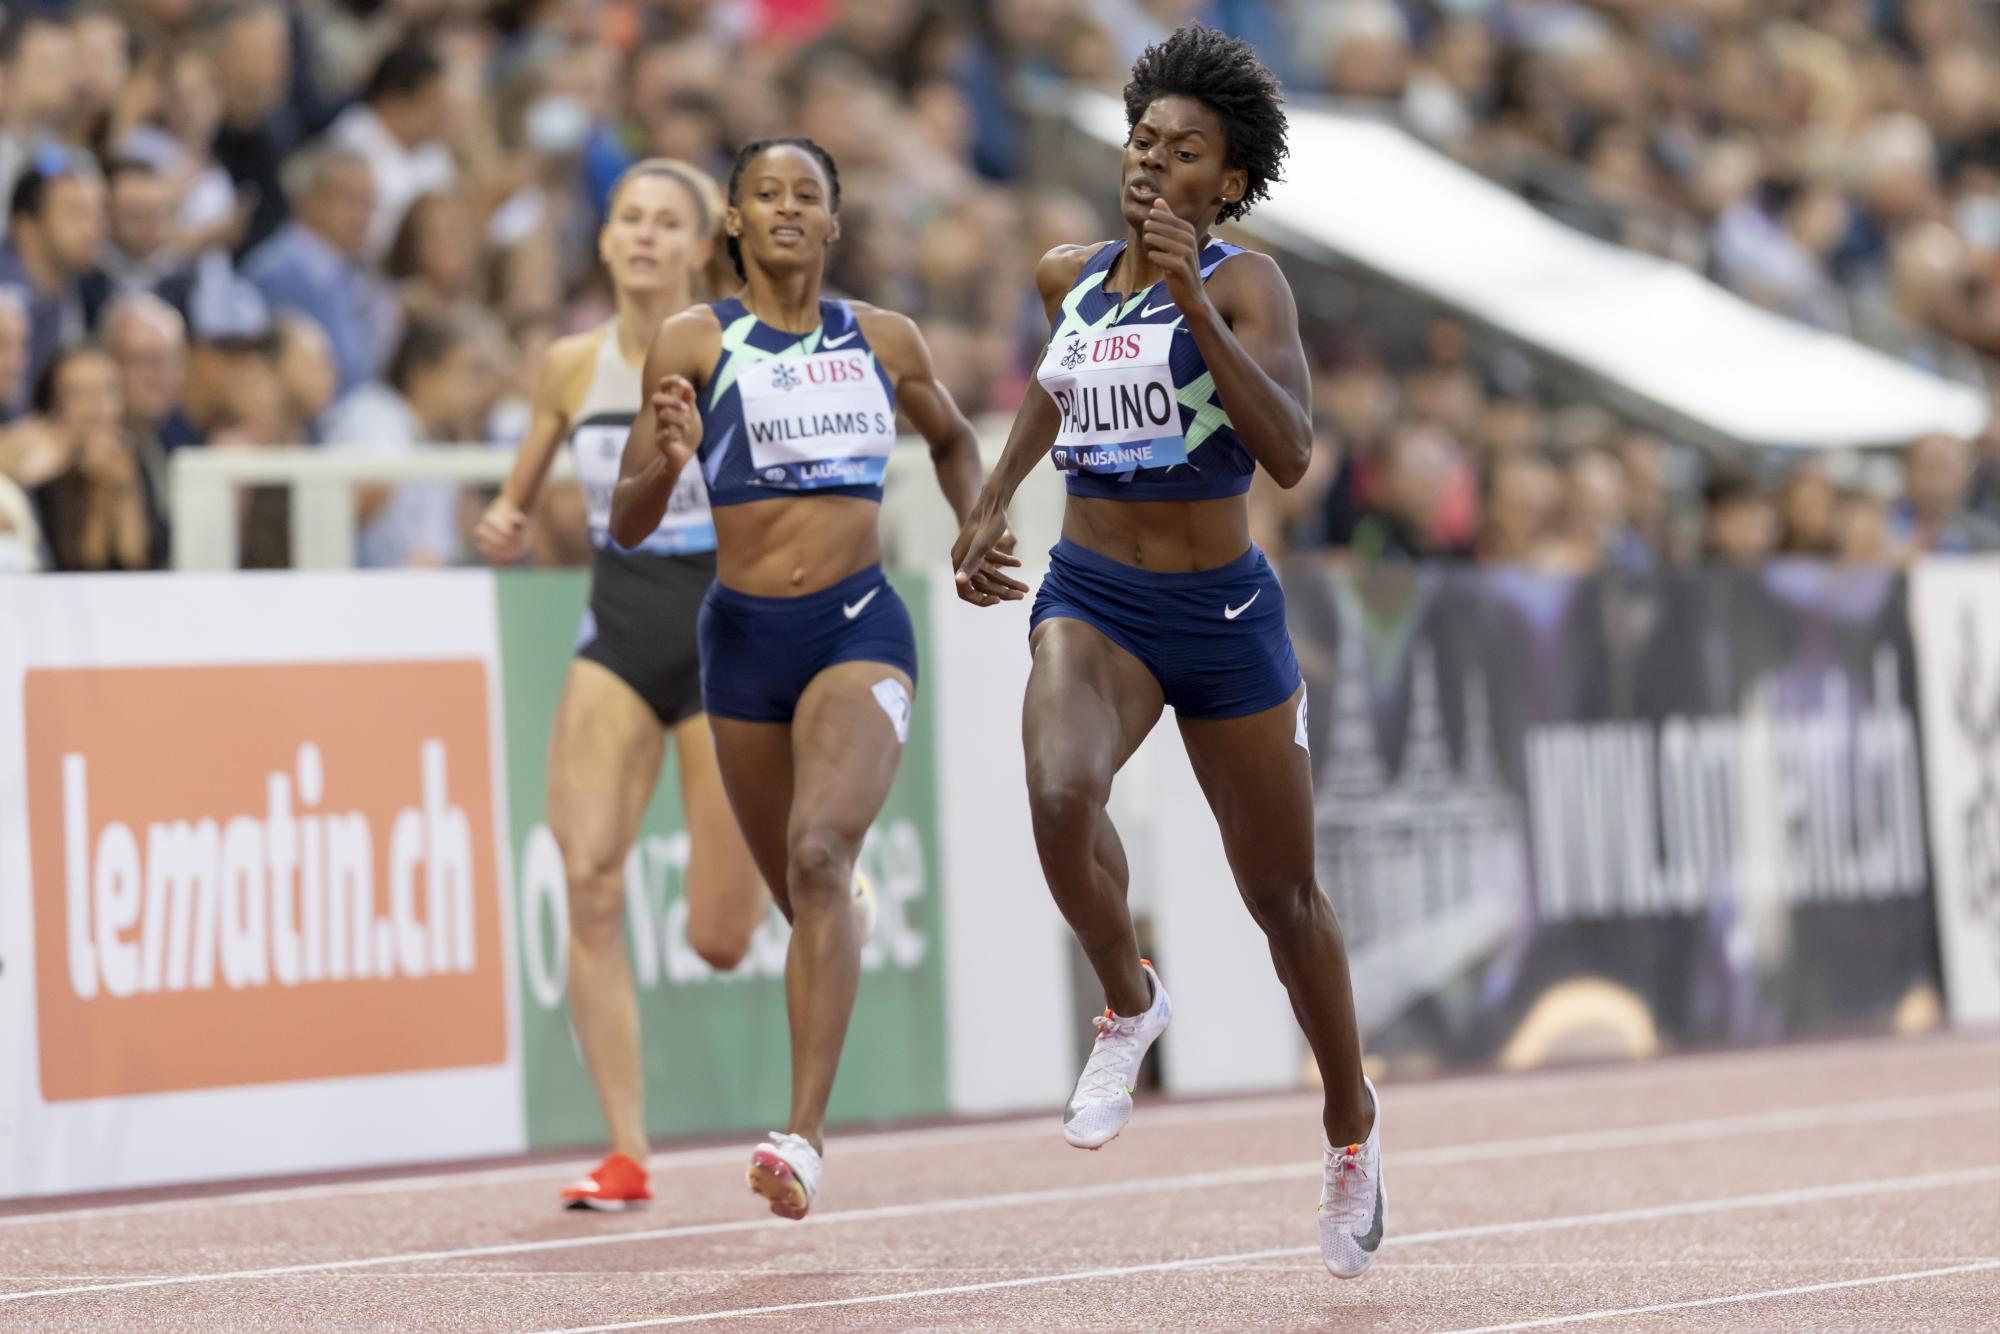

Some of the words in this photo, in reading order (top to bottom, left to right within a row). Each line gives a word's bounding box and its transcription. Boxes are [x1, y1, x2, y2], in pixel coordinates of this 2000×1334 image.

[1092, 333, 1141, 363] UBS
[805, 357, 865, 384] UBS
[1053, 381, 1171, 433] PAULINO
[751, 412, 869, 443] WILLIAMS
[875, 413, 893, 435] S.
[1075, 446, 1153, 466] LAUSANNE
[62, 738, 477, 1000] lematin.ch
